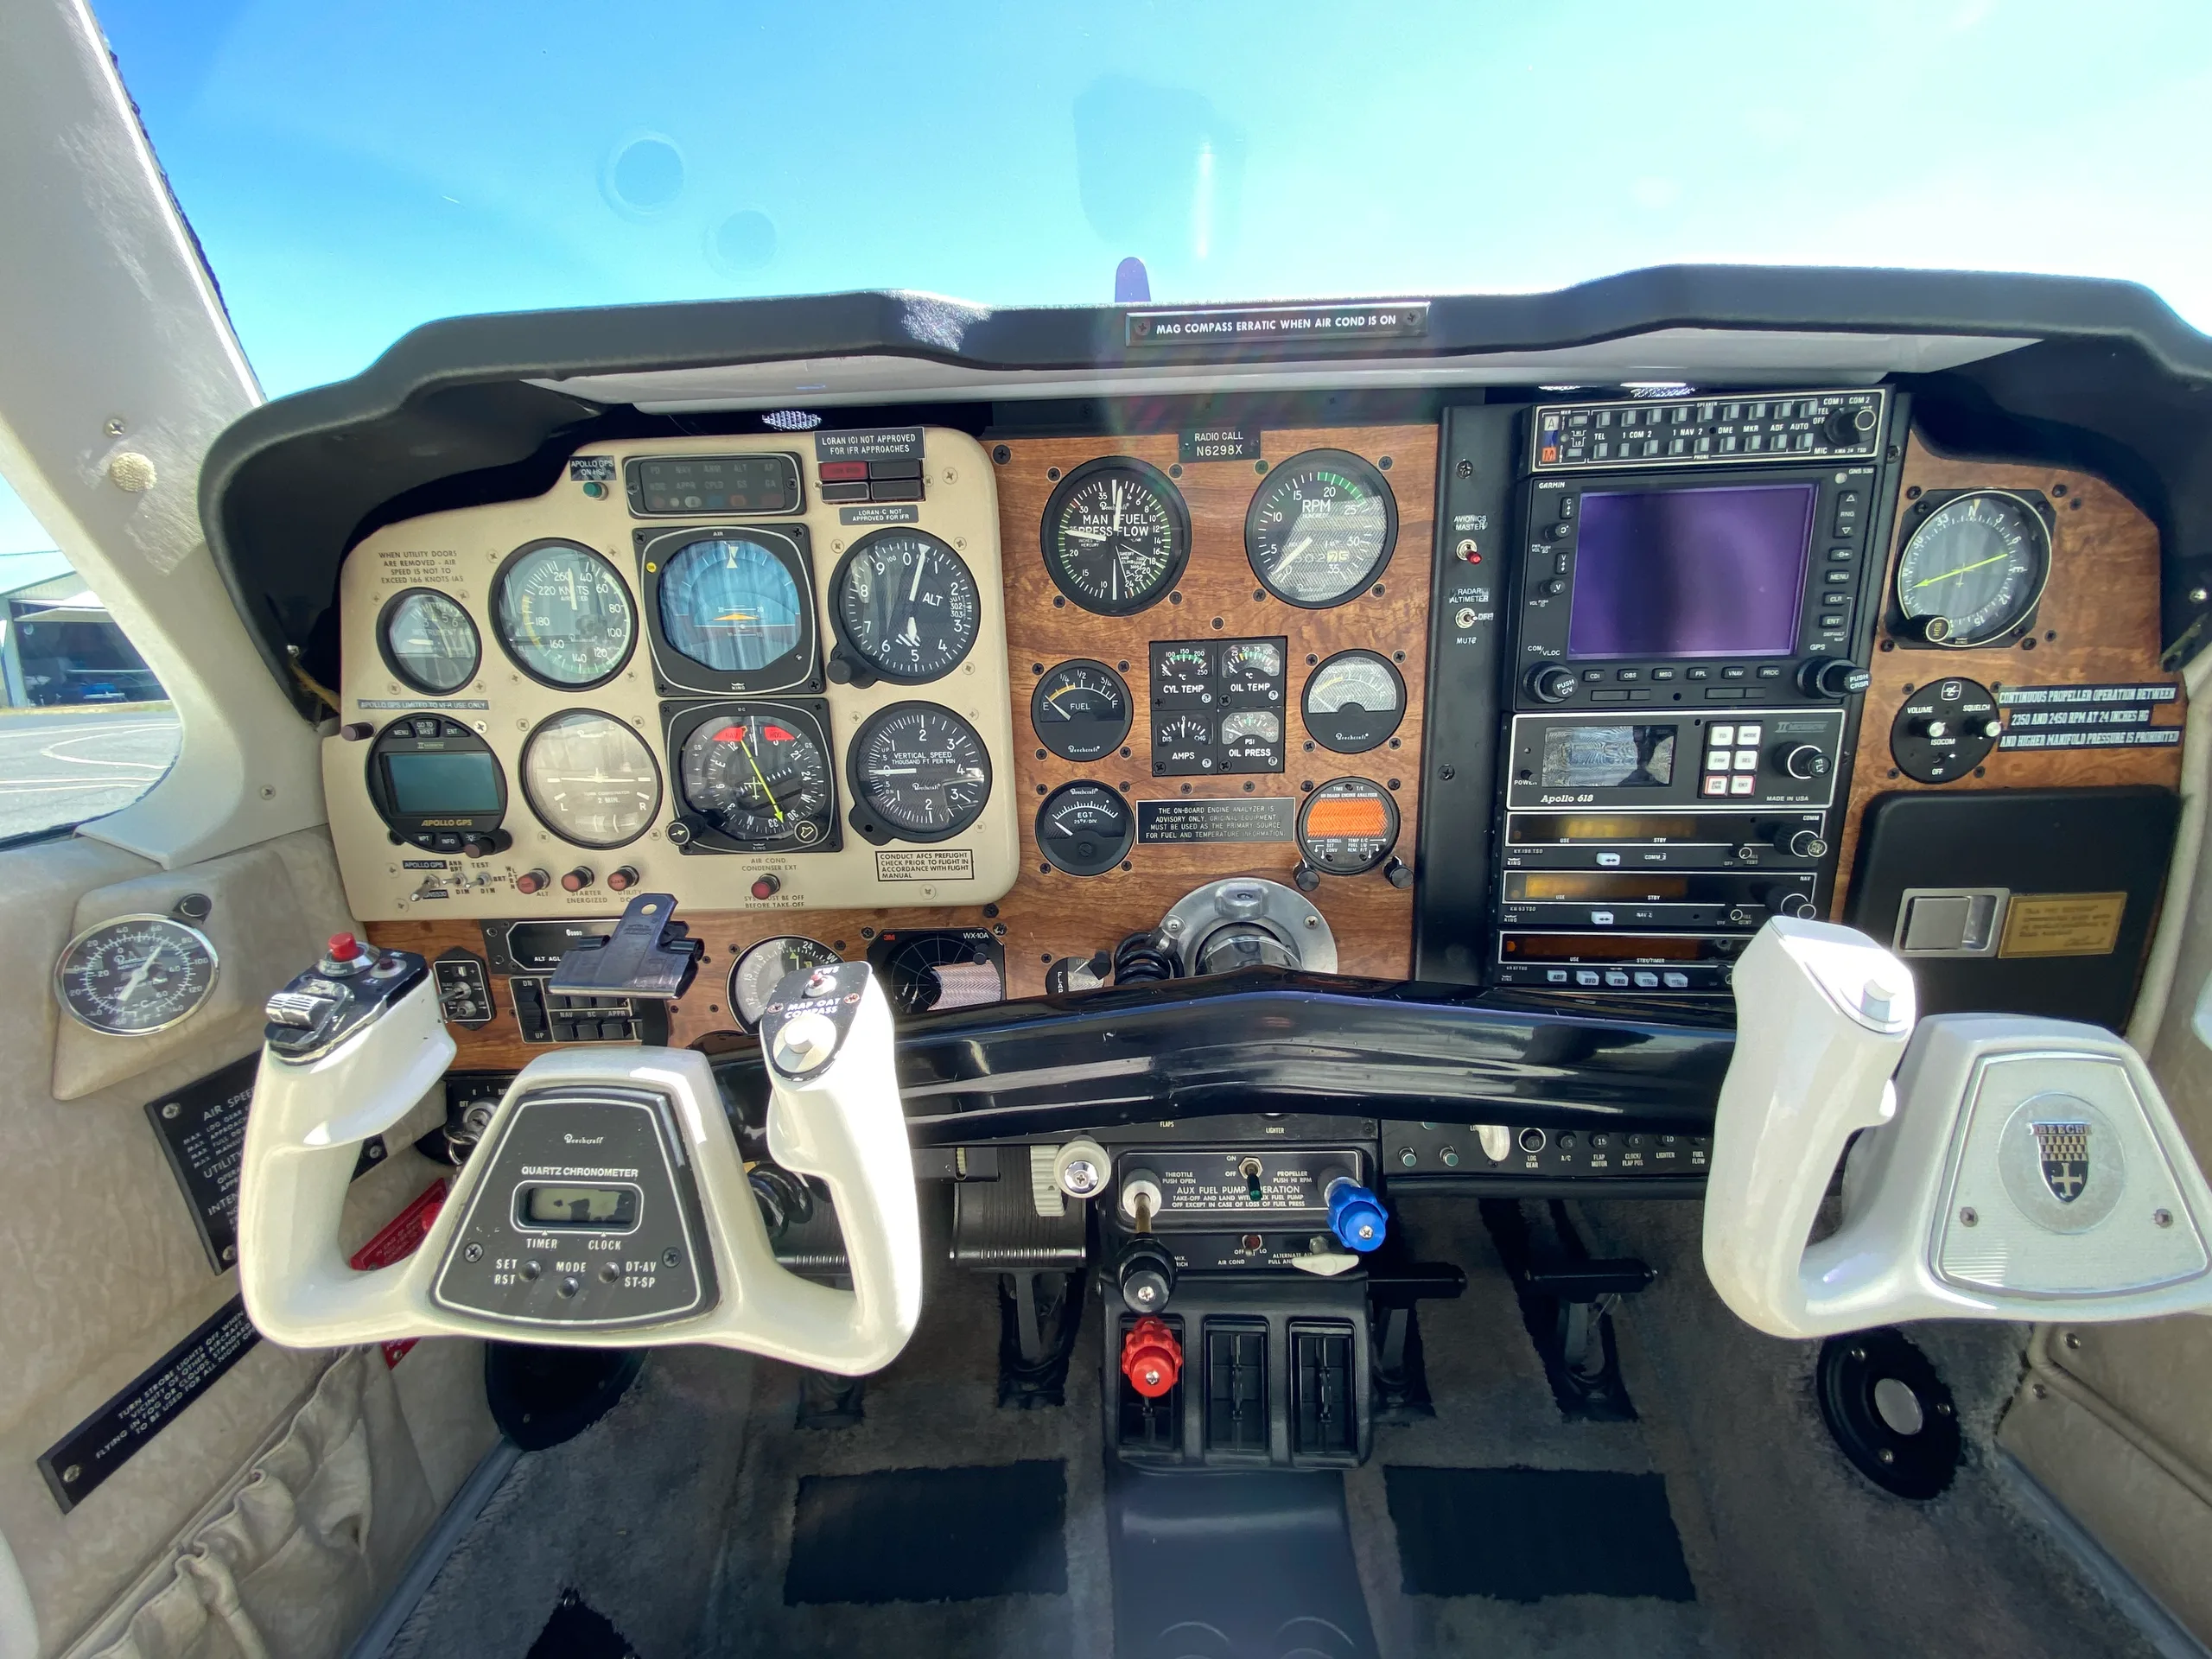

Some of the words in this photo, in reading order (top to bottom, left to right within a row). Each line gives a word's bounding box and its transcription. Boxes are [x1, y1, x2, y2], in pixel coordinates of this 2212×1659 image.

[1156, 324, 1181, 334] MAG
[1185, 322, 1232, 333] COMPASS
[1236, 320, 1276, 331] ERRATIC
[1280, 319, 1310, 329] WHEN
[1315, 318, 1332, 327] AIR
[1335, 316, 1365, 327] COND
[1368, 316, 1376, 325] IS
[1380, 315, 1396, 325] ON
[822, 437, 846, 445] LORAN
[877, 434, 916, 442] APPROVED
[1195, 432, 1219, 442] RADIO
[1222, 432, 1243, 440] CALL
[861, 445, 909, 454] APPROACHES
[1197, 444, 1242, 456] N6298X
[1302, 499, 1331, 513] RPM
[1083, 515, 1108, 524] MAN
[538, 586, 556, 595] 220
[923, 593, 943, 606] ALT
[536, 617, 550, 626] 180
[607, 628, 622, 637] 100
[550, 640, 564, 648] 160
[594, 648, 607, 657] 120
[572, 654, 587, 662] 140
[1181, 685, 1204, 693] TEMP
[1999, 691, 2047, 704] CONTINUOUS
[2048, 690, 2092, 702] PROPELLER
[2093, 689, 2136, 701] OPERATION
[2136, 687, 2176, 700] BETWEEN
[2011, 714, 2030, 726] 2350
[2031, 714, 2048, 725] AND
[2049, 712, 2067, 724] 2450
[2068, 712, 2086, 723] RPM
[2087, 712, 2099, 723] AT
[2099, 711, 2109, 723] 24
[2110, 710, 2137, 722] INCHES
[2138, 710, 2149, 721] HG
[1999, 736, 2016, 748] AND
[2017, 735, 2045, 747] HIGHER
[2046, 733, 2086, 745] MANIFOLD
[2086, 732, 2125, 744] PRESSURE
[2126, 732, 2134, 743] IS
[2135, 731, 2180, 743] PROHIBITED
[1541, 795, 1574, 804] Apollo
[203, 1105, 224, 1121] AIR
[2039, 1125, 2084, 1134] BEECH
[522, 1166, 562, 1176] QUARTZ
[563, 1167, 638, 1177] CHRONOMETER
[526, 1238, 557, 1248] TIMER
[588, 1240, 621, 1250] CLOCK
[496, 1259, 517, 1269] SET
[556, 1262, 586, 1272] MODE
[626, 1262, 656, 1272] DT-AV
[494, 1275, 515, 1285] RST
[625, 1277, 655, 1288] ST-SP
[130, 1387, 165, 1419] VICINITY
[169, 1375, 179, 1386] OF
[181, 1352, 207, 1375] OTHER
[208, 1320, 243, 1353] AIRCRAFT
[118, 1397, 142, 1419] TURN
[144, 1371, 174, 1397] STROBE
[176, 1345, 203, 1372] LIGHTS
[162, 1392, 183, 1412] USED
[185, 1377, 201, 1393] FOR
[96, 1429, 128, 1460] FLYING
[143, 1400, 161, 1419] FOG
